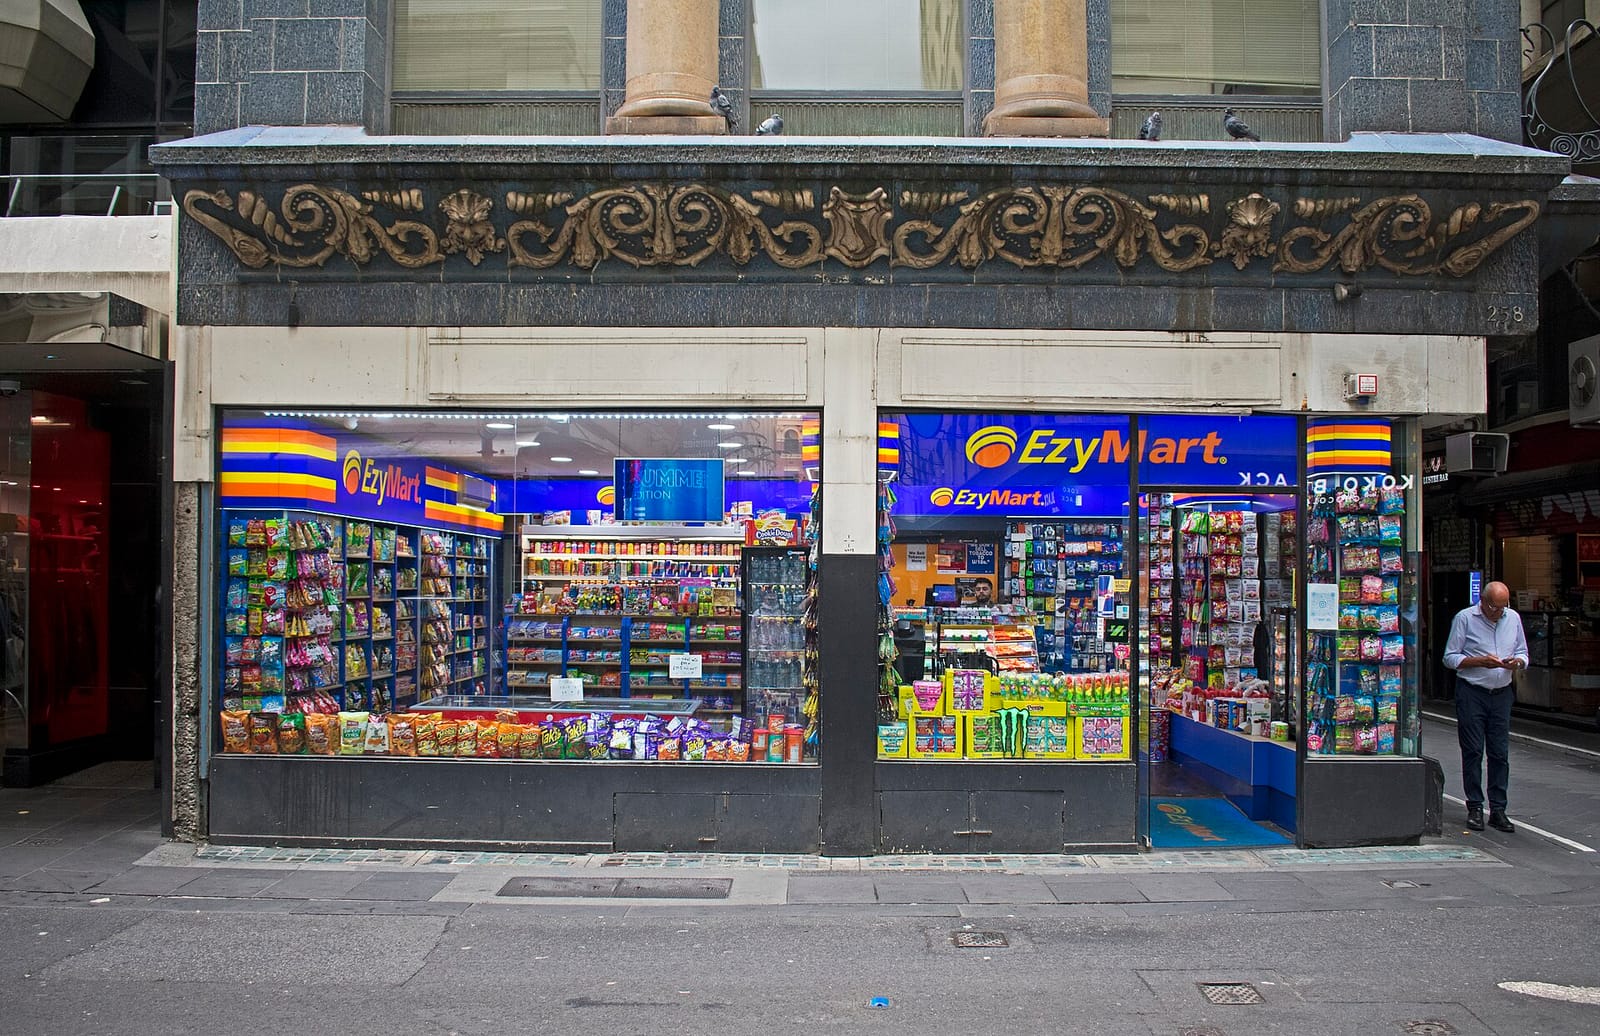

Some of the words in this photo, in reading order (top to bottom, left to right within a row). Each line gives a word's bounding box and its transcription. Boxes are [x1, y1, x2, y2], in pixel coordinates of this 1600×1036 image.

[1487, 305, 1524, 323] 258
[541, 726, 562, 747] Takis
[565, 720, 587, 743] Takis
